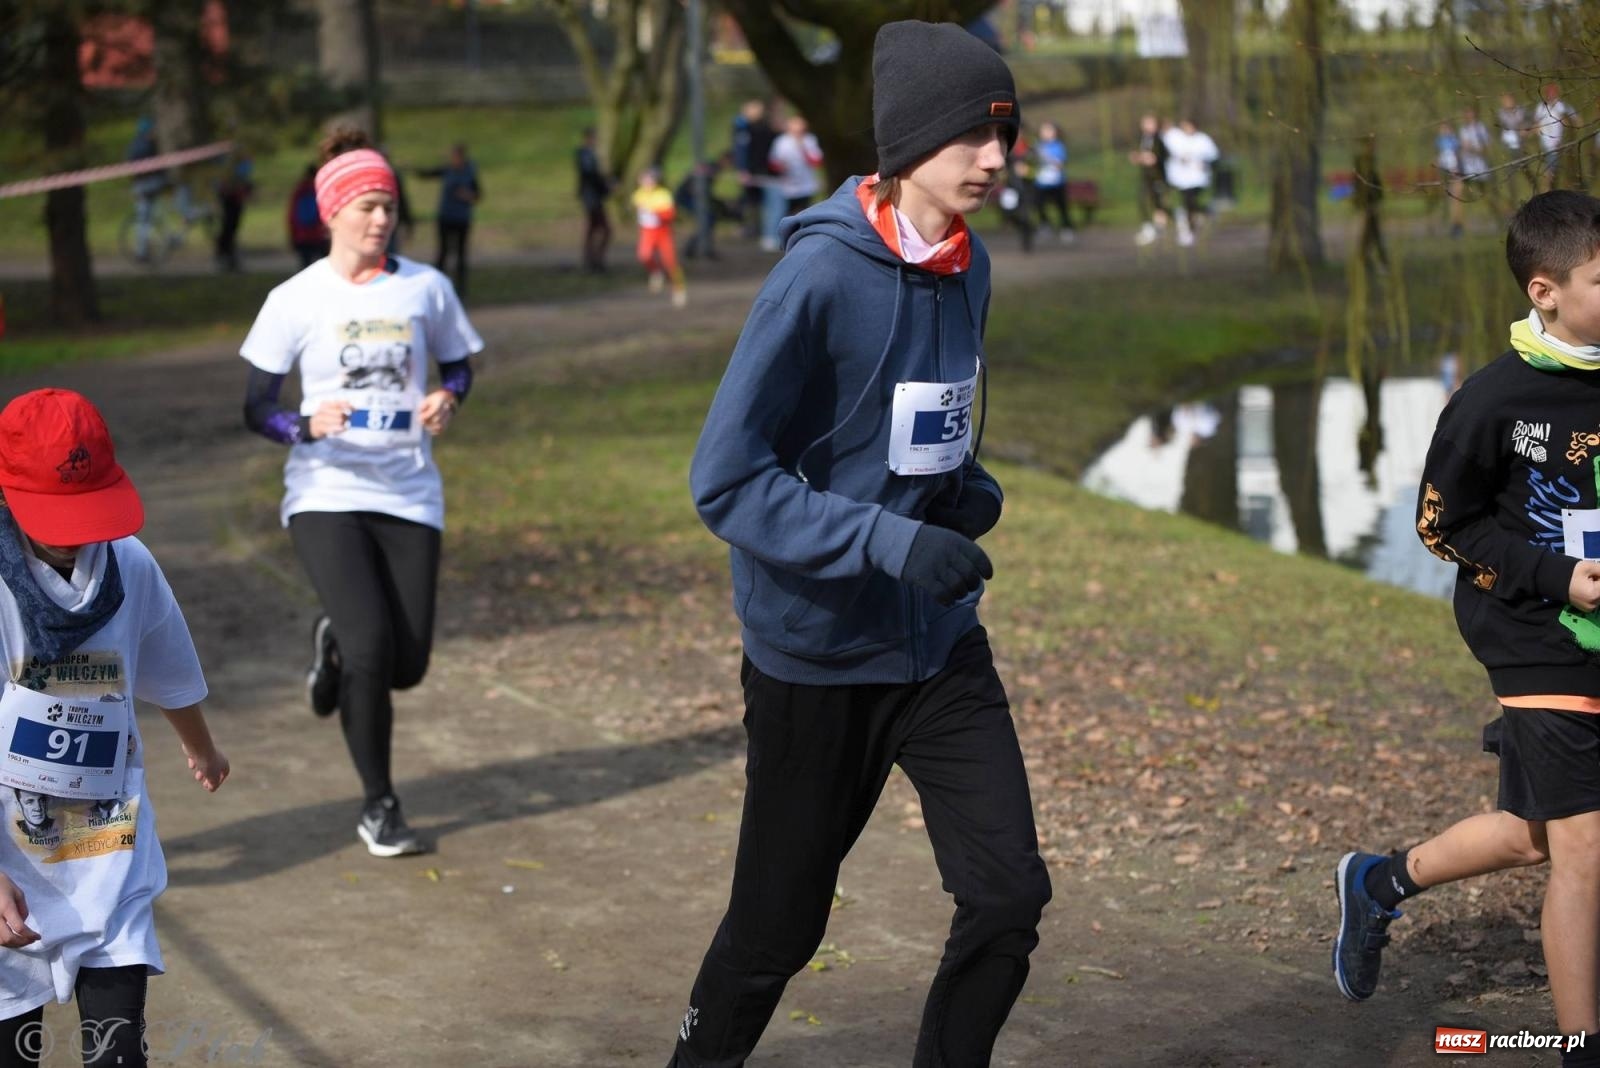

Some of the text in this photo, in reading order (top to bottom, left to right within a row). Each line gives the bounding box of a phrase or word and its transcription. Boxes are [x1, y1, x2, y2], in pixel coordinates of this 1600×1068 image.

[367, 408, 397, 430] 87
[941, 405, 971, 440] 53
[1512, 420, 1551, 442] BOOM!
[1512, 435, 1540, 458] TNT
[56, 664, 119, 681] WILCZYM
[66, 713, 105, 725] WILCZYM
[46, 729, 90, 763] 91
